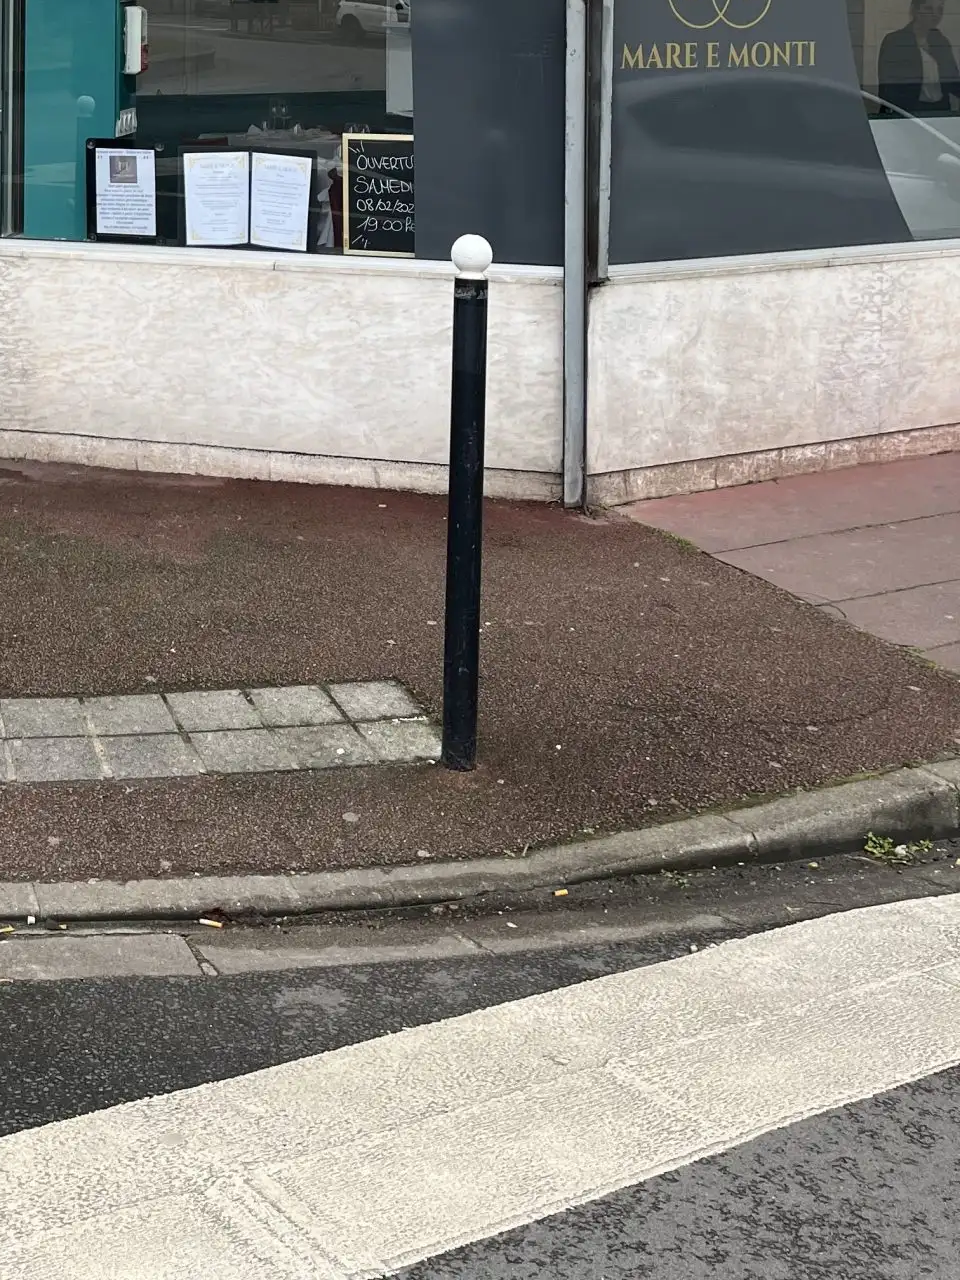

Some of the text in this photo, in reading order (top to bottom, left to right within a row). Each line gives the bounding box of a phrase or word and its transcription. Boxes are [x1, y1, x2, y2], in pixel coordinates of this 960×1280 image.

[620, 40, 816, 70] MARE E MONTI
[353, 175, 414, 195] SAMEDI
[356, 216, 378, 232] 19
